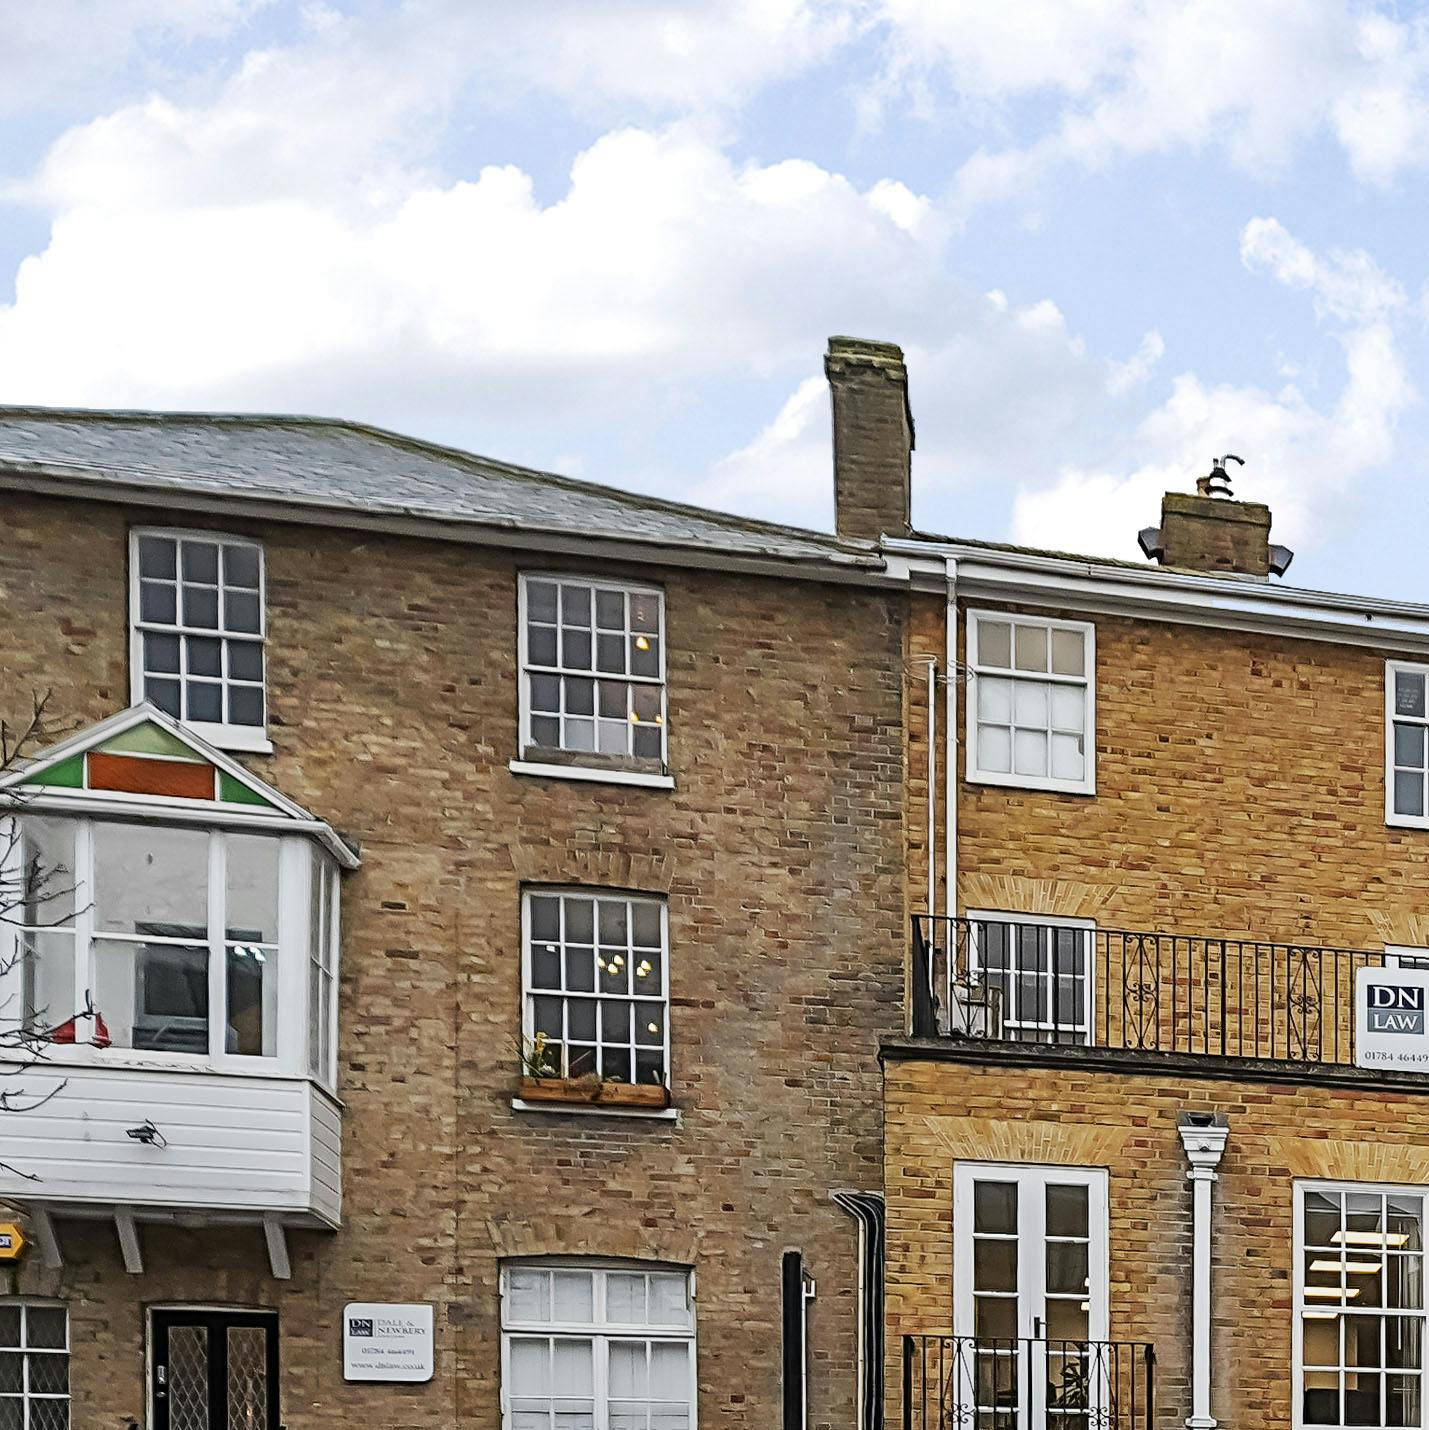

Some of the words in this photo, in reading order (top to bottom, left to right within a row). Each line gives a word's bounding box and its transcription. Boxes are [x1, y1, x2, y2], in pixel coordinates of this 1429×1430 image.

[1373, 986, 1419, 1009] DN
[1373, 1013, 1417, 1030] LAW
[1364, 1051, 1393, 1062] 01784
[352, 1319, 371, 1327] DN
